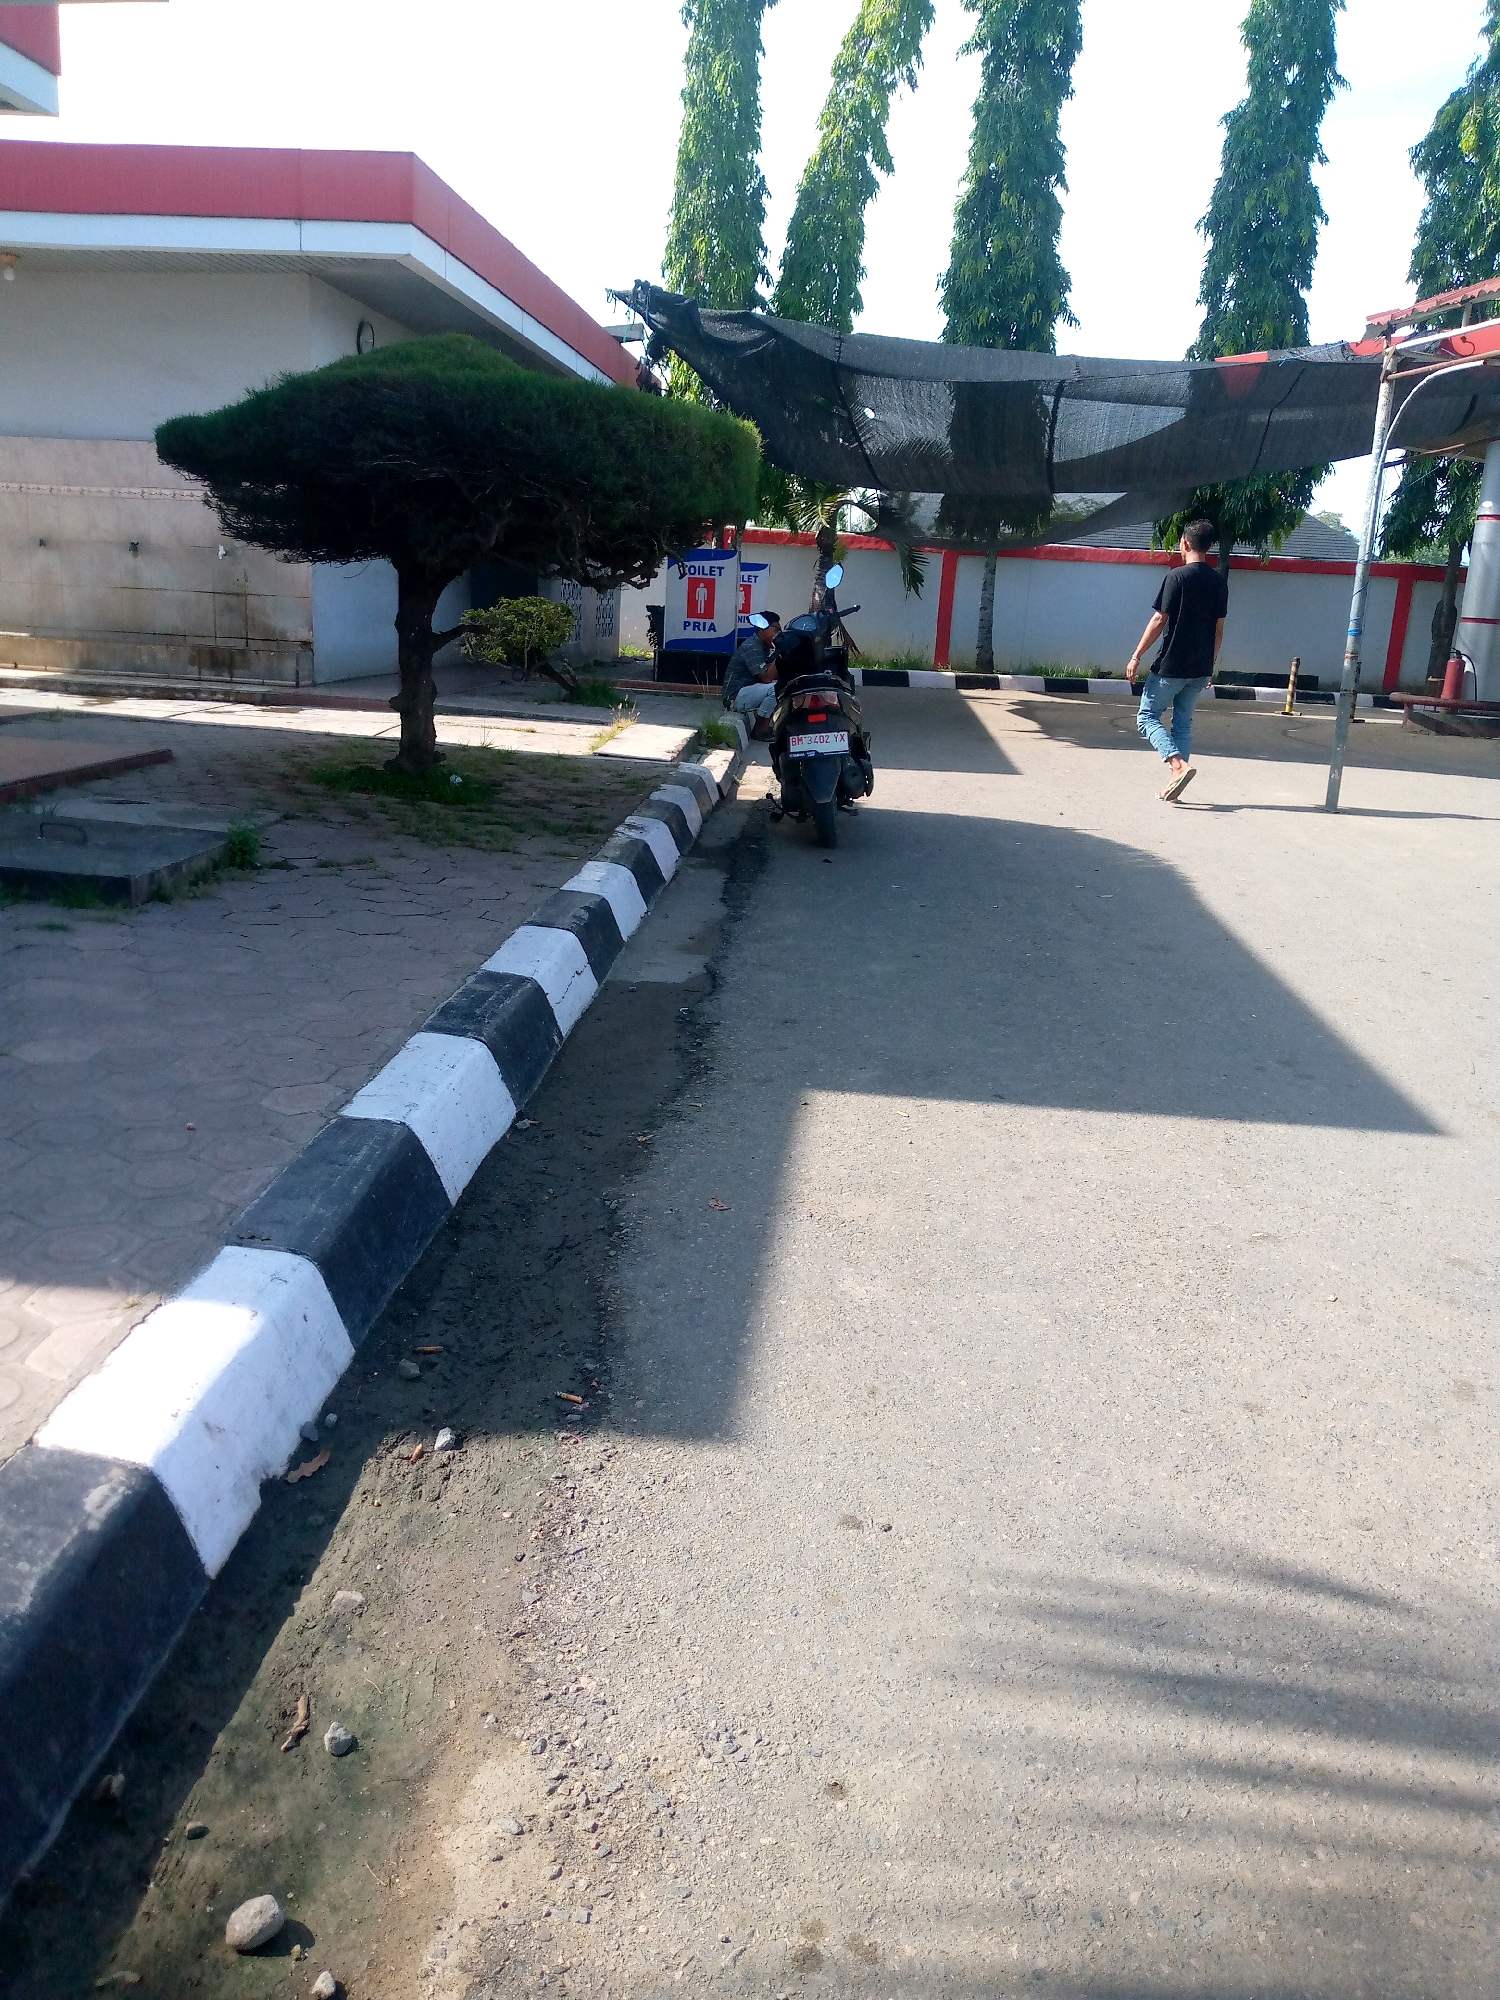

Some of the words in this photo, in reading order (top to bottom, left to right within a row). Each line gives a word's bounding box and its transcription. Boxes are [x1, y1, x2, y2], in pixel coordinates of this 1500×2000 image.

[683, 621, 717, 632] PRIA
[791, 737, 804, 746] BM
[834, 733, 845, 743] YX
